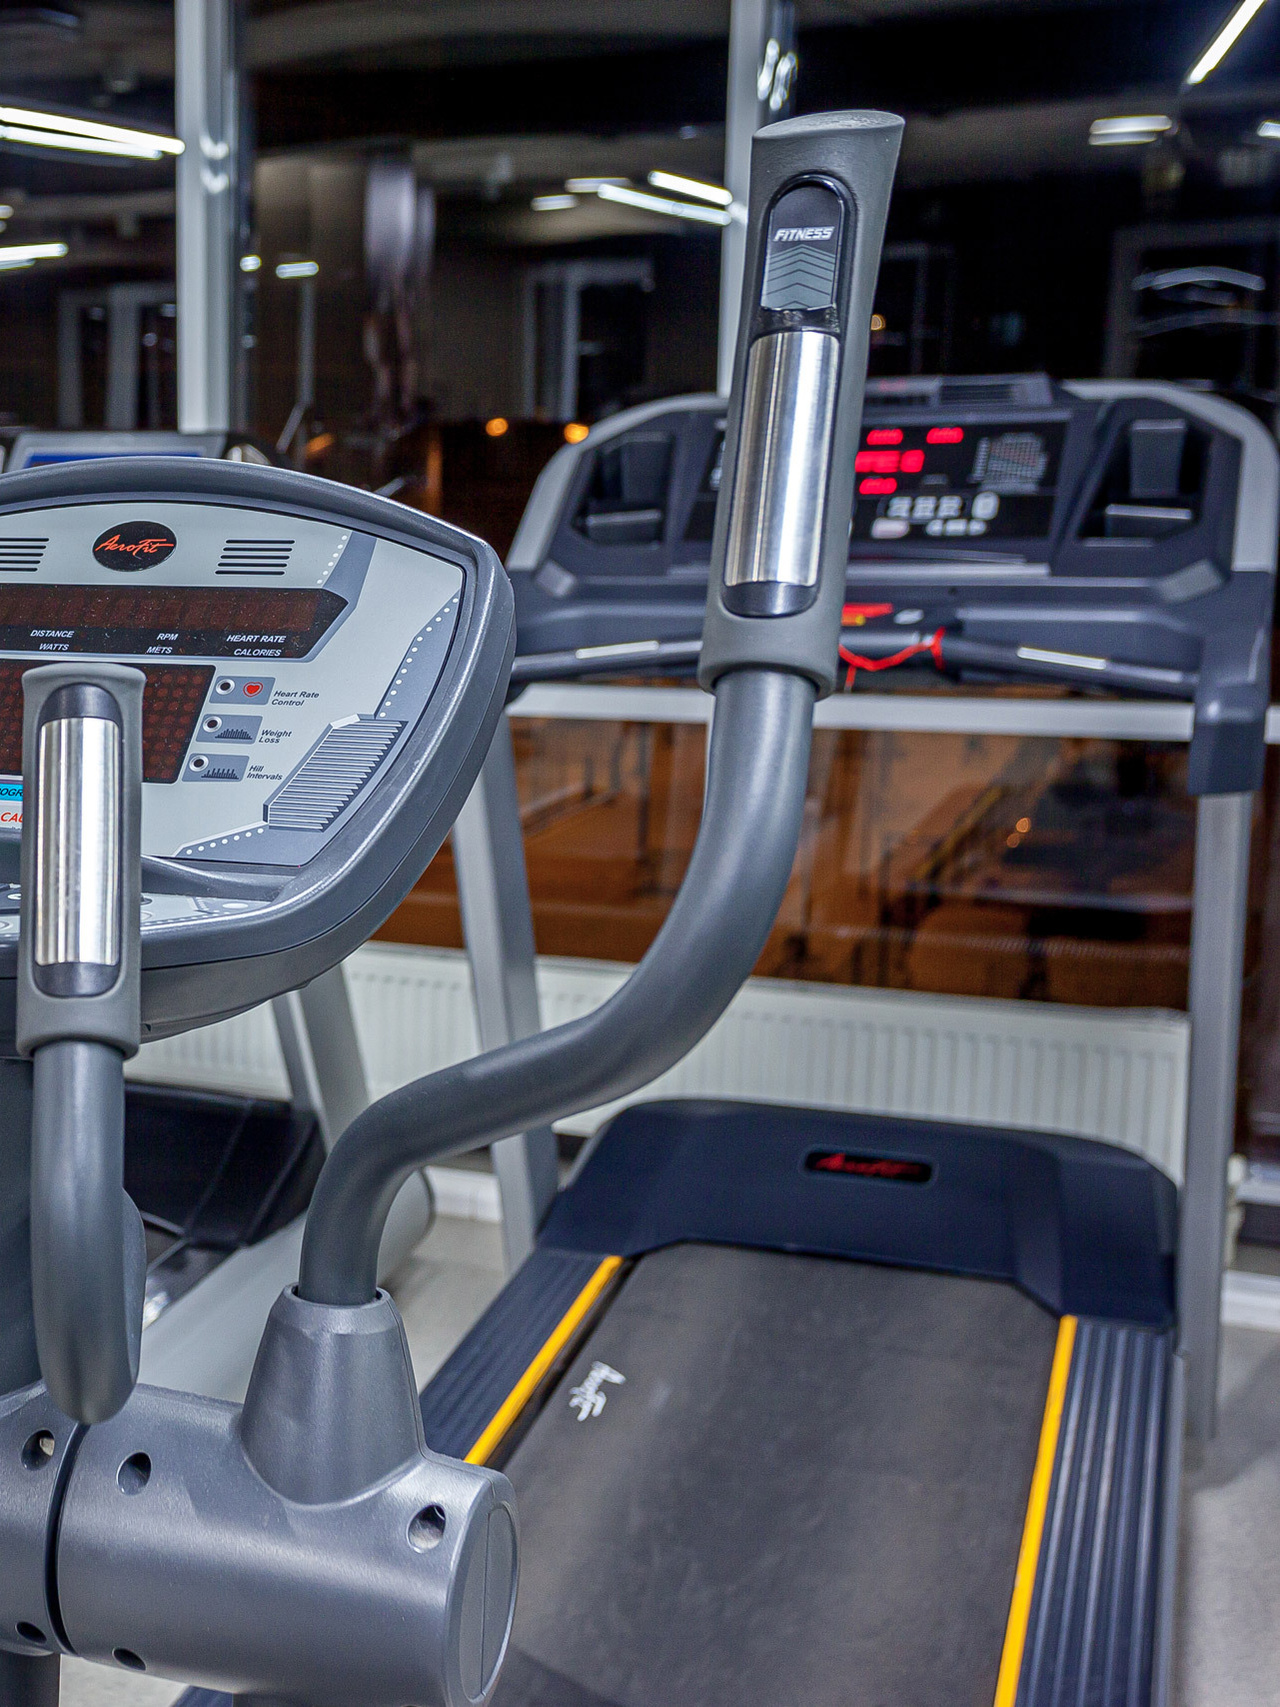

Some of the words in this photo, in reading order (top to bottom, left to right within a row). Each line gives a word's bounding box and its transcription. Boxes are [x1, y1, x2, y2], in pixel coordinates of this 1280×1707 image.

[773, 226, 835, 241] FITNESS
[30, 629, 74, 638] DISTANCE
[156, 633, 179, 641] RPM
[226, 634, 259, 643] HEART
[260, 635, 286, 643] RATE
[38, 643, 70, 651] WATTS
[146, 646, 173, 654] METS
[233, 648, 282, 657] CALORIES
[273, 690, 298, 698] Heart
[299, 691, 320, 699] Rate
[261, 729, 292, 738] Weight
[246, 772, 283, 780] Intervals
